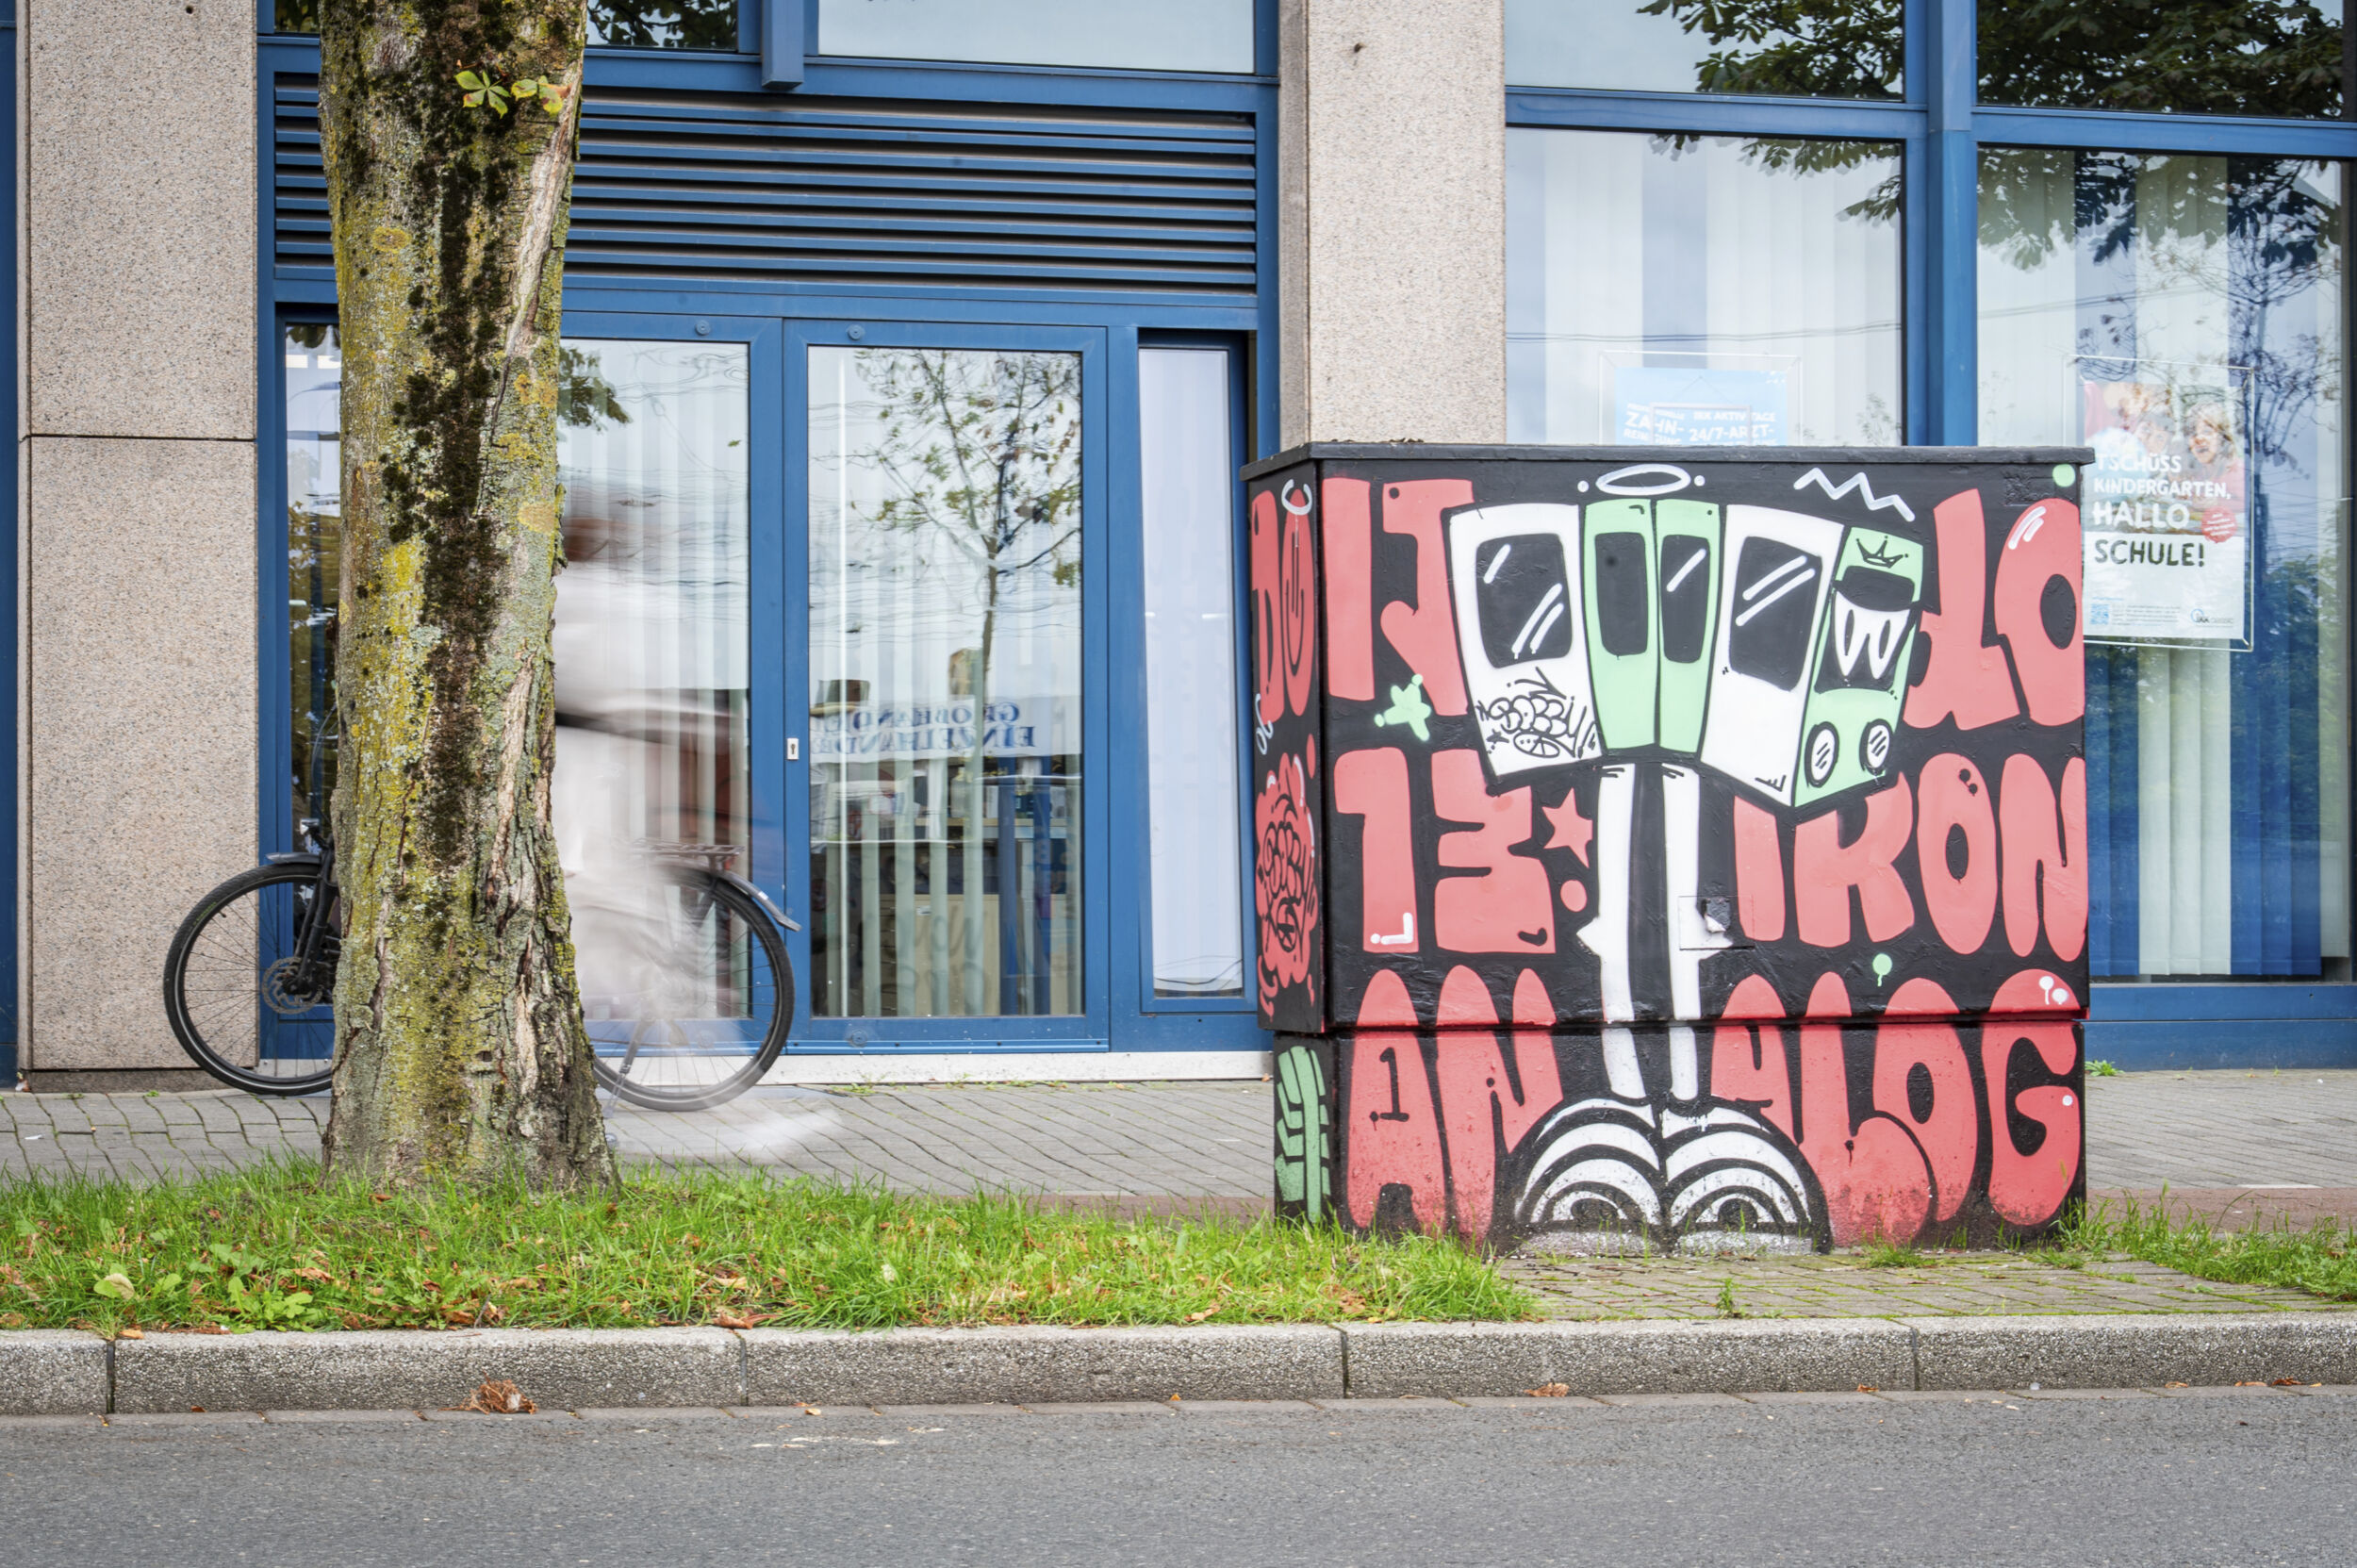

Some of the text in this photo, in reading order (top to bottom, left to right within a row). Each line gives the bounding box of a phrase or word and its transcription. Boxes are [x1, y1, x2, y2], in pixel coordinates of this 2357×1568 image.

[2095, 452, 2182, 473] TSCHÜSS
[2093, 476, 2232, 500] KINDERGARTEN,
[2092, 501, 2190, 529] HALLO
[2094, 538, 2205, 568] SCHULE!
